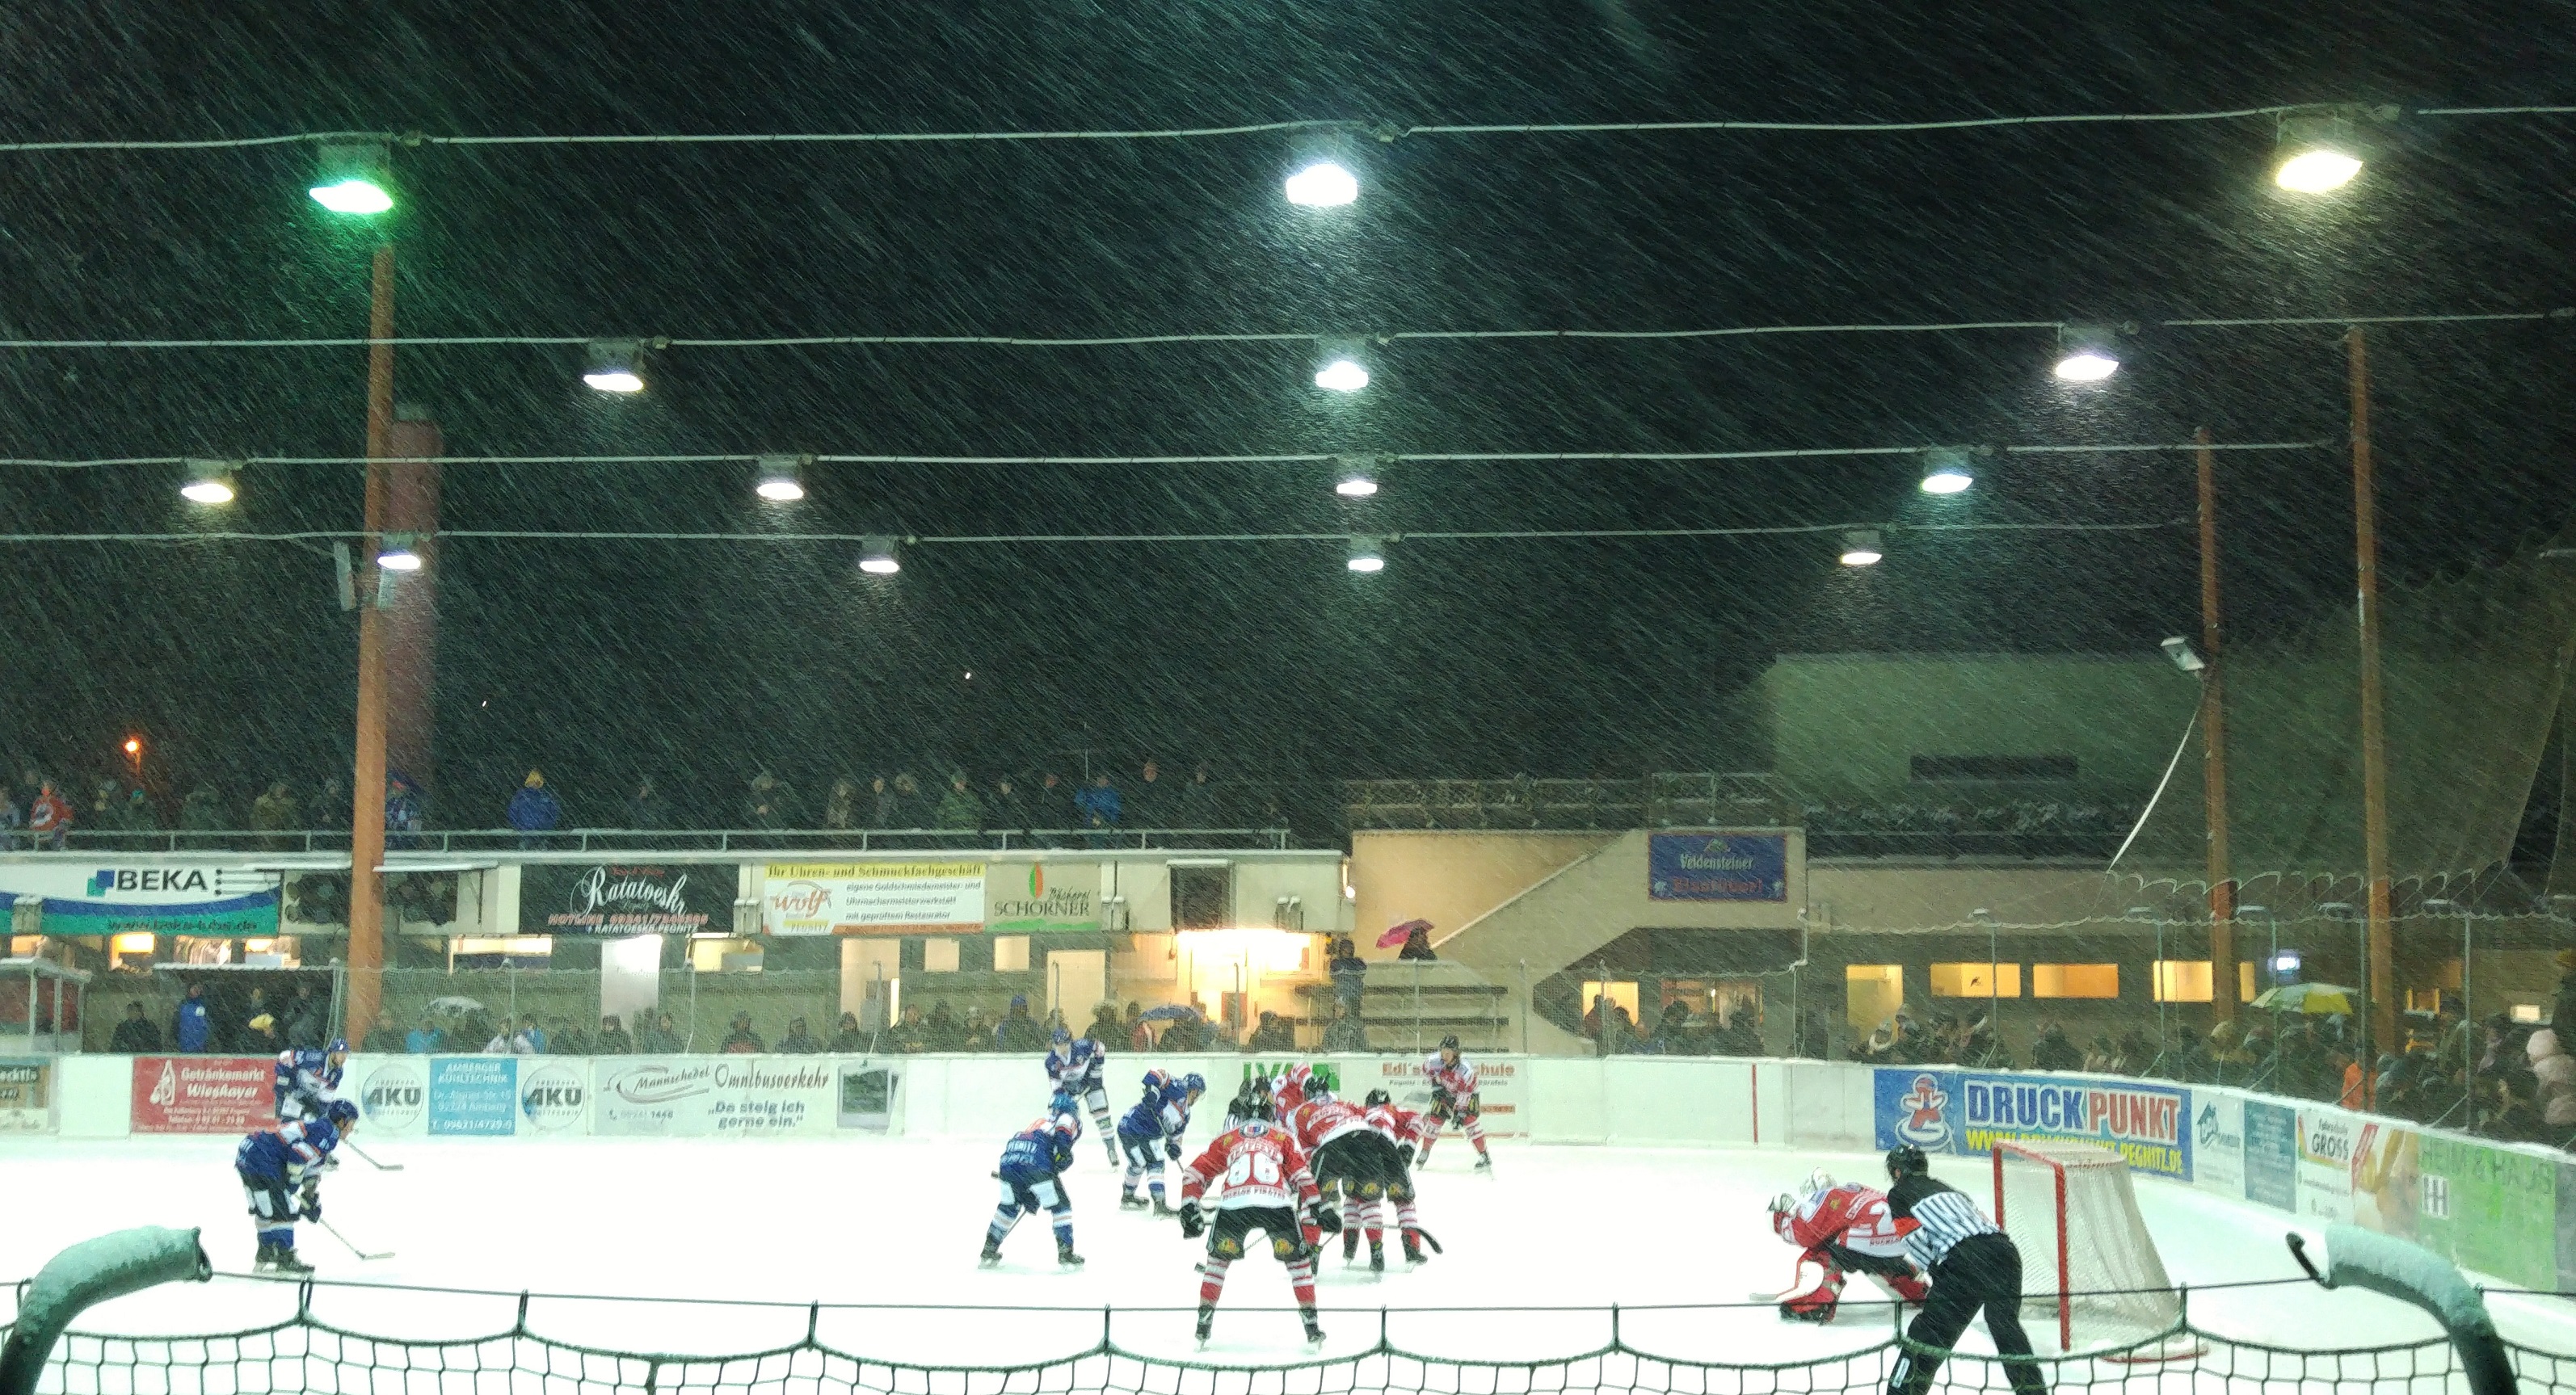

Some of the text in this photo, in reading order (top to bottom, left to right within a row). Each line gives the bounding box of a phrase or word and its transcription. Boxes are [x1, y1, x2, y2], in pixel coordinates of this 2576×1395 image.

[116, 868, 208, 892] BEKA
[768, 864, 982, 880] Ihr Uhren- und Schmuckfachgeschäft
[367, 1087, 421, 1106] AKU
[525, 1087, 583, 1107] AKU
